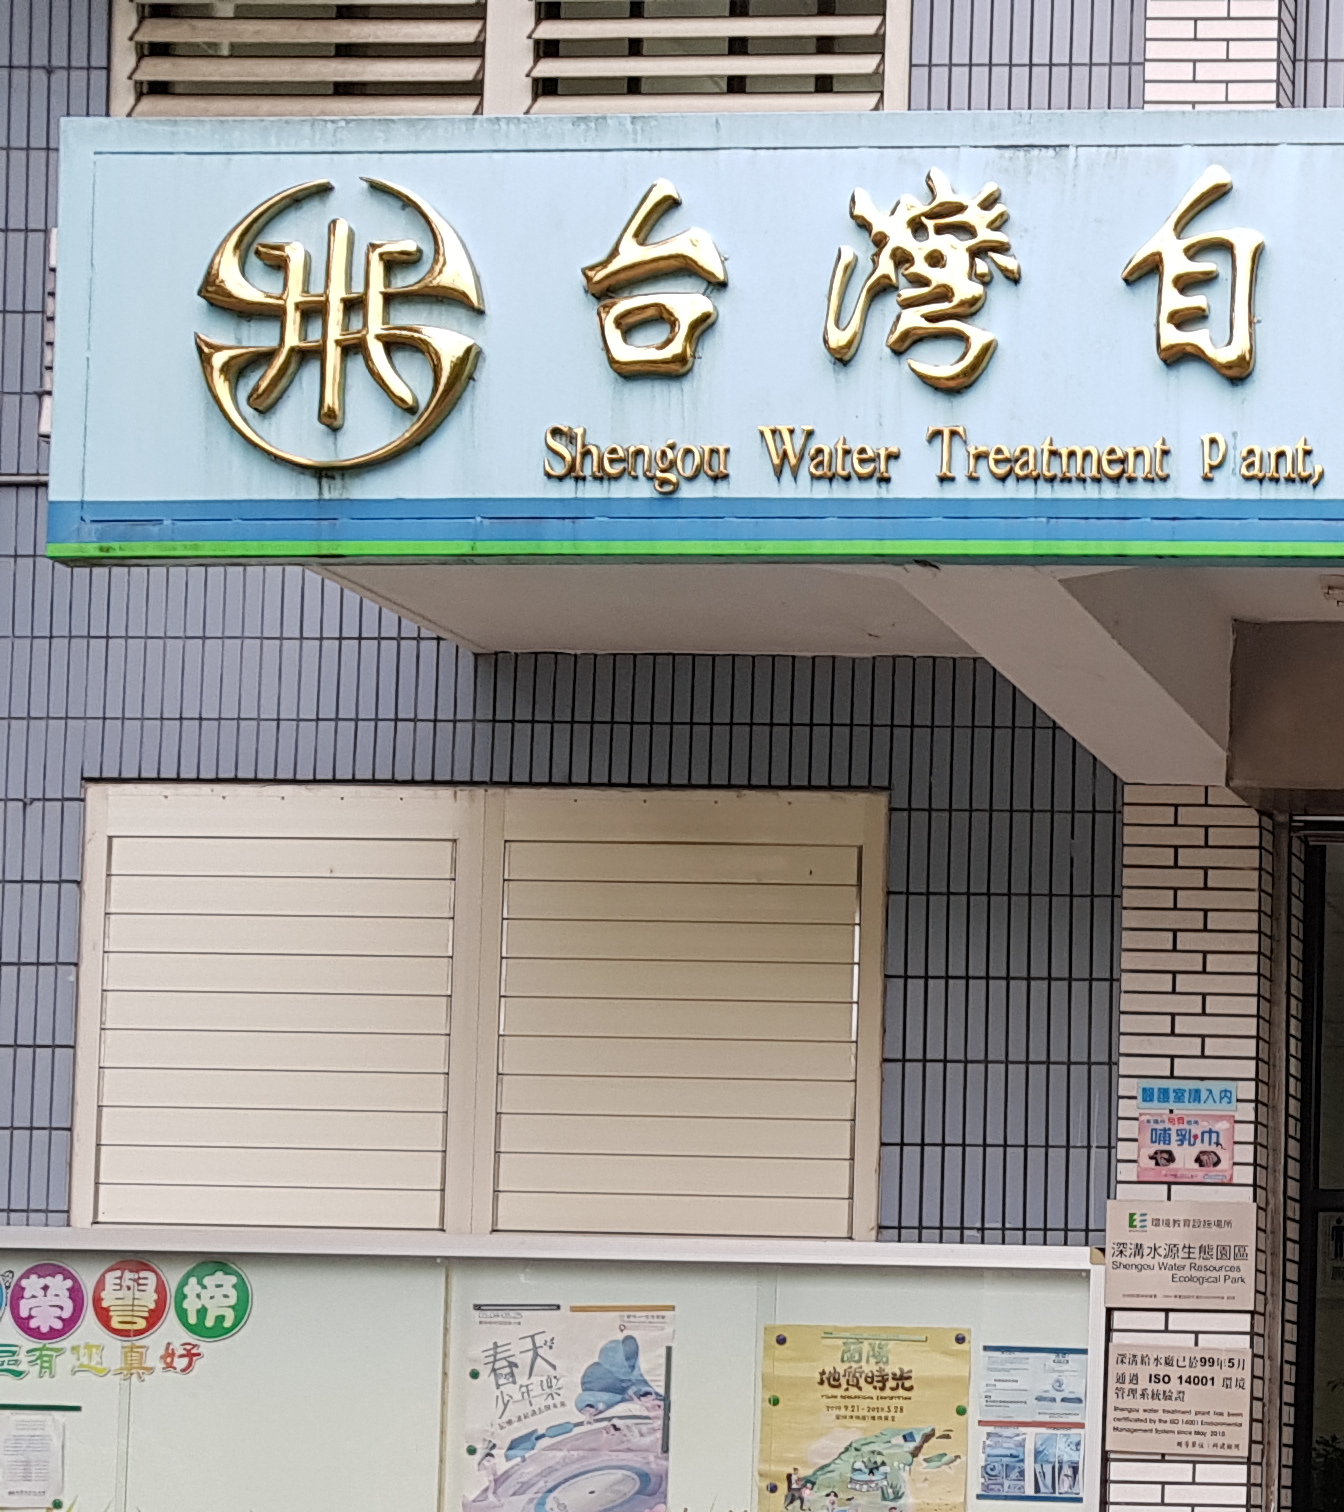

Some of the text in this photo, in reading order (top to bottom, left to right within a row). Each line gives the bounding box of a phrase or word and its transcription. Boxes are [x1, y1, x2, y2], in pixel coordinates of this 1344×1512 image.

[544, 424, 730, 493] Shengou
[758, 424, 901, 482] Water
[926, 424, 1171, 483] Treatment
[1199, 432, 1324, 488] Pant,
[1150, 1127, 1221, 1147] 哺乳巾
[1111, 1242, 1249, 1261] 深溝水源生態園區
[1111, 1261, 1241, 1273] Shengou Water Resources
[1171, 1273, 1246, 1285] Ecological Park
[19, 1269, 239, 1333] 榮譽榜
[817, 1366, 914, 1392] 地質時光
[1149, 1374, 1171, 1385] ISO
[1177, 1375, 1215, 1386] 14001
